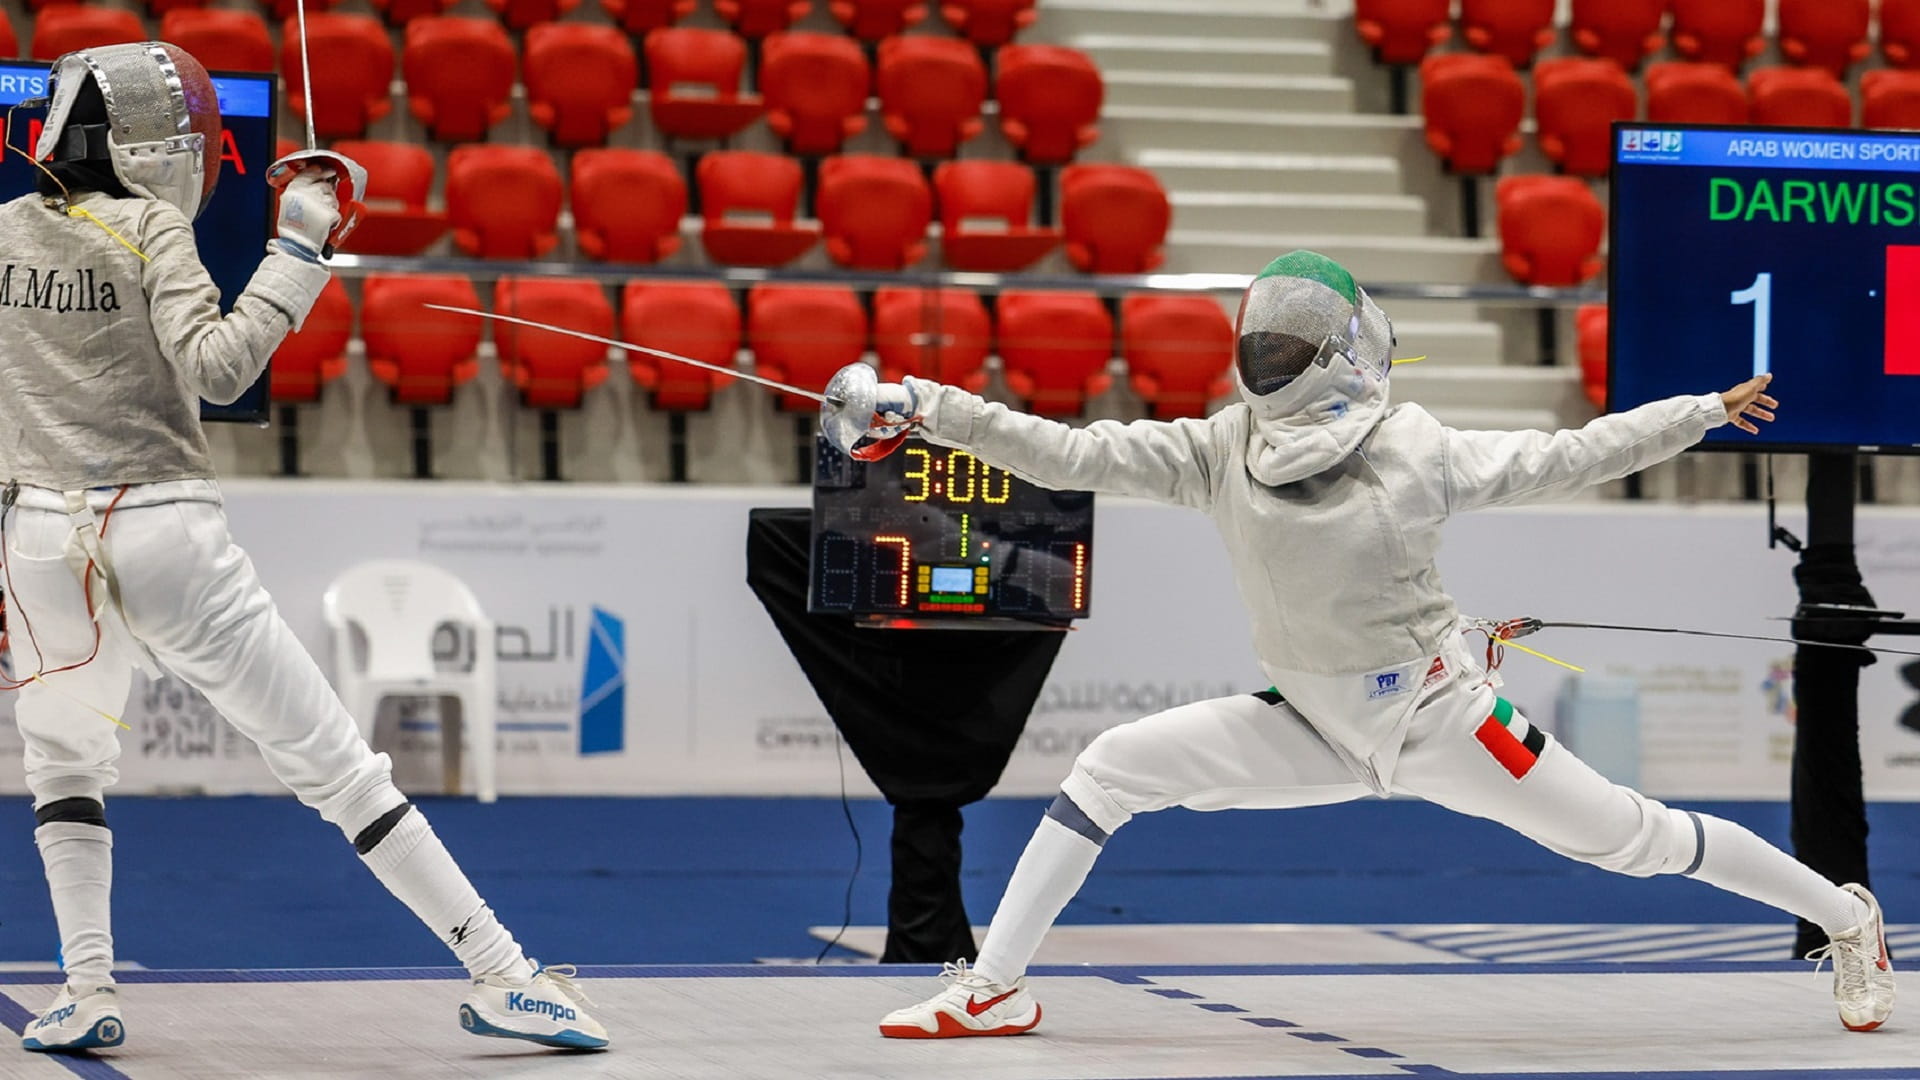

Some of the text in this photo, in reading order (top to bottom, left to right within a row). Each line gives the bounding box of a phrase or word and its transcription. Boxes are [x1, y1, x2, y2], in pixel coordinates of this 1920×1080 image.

[1727, 139, 1778, 158] ARAB
[1782, 141, 1855, 160] WOMEN
[1709, 177, 1920, 227] DARWIS
[1730, 272, 1771, 378] 1
[904, 447, 1011, 504] 3:00
[874, 535, 911, 606] 7
[508, 991, 577, 1021] Kempa
